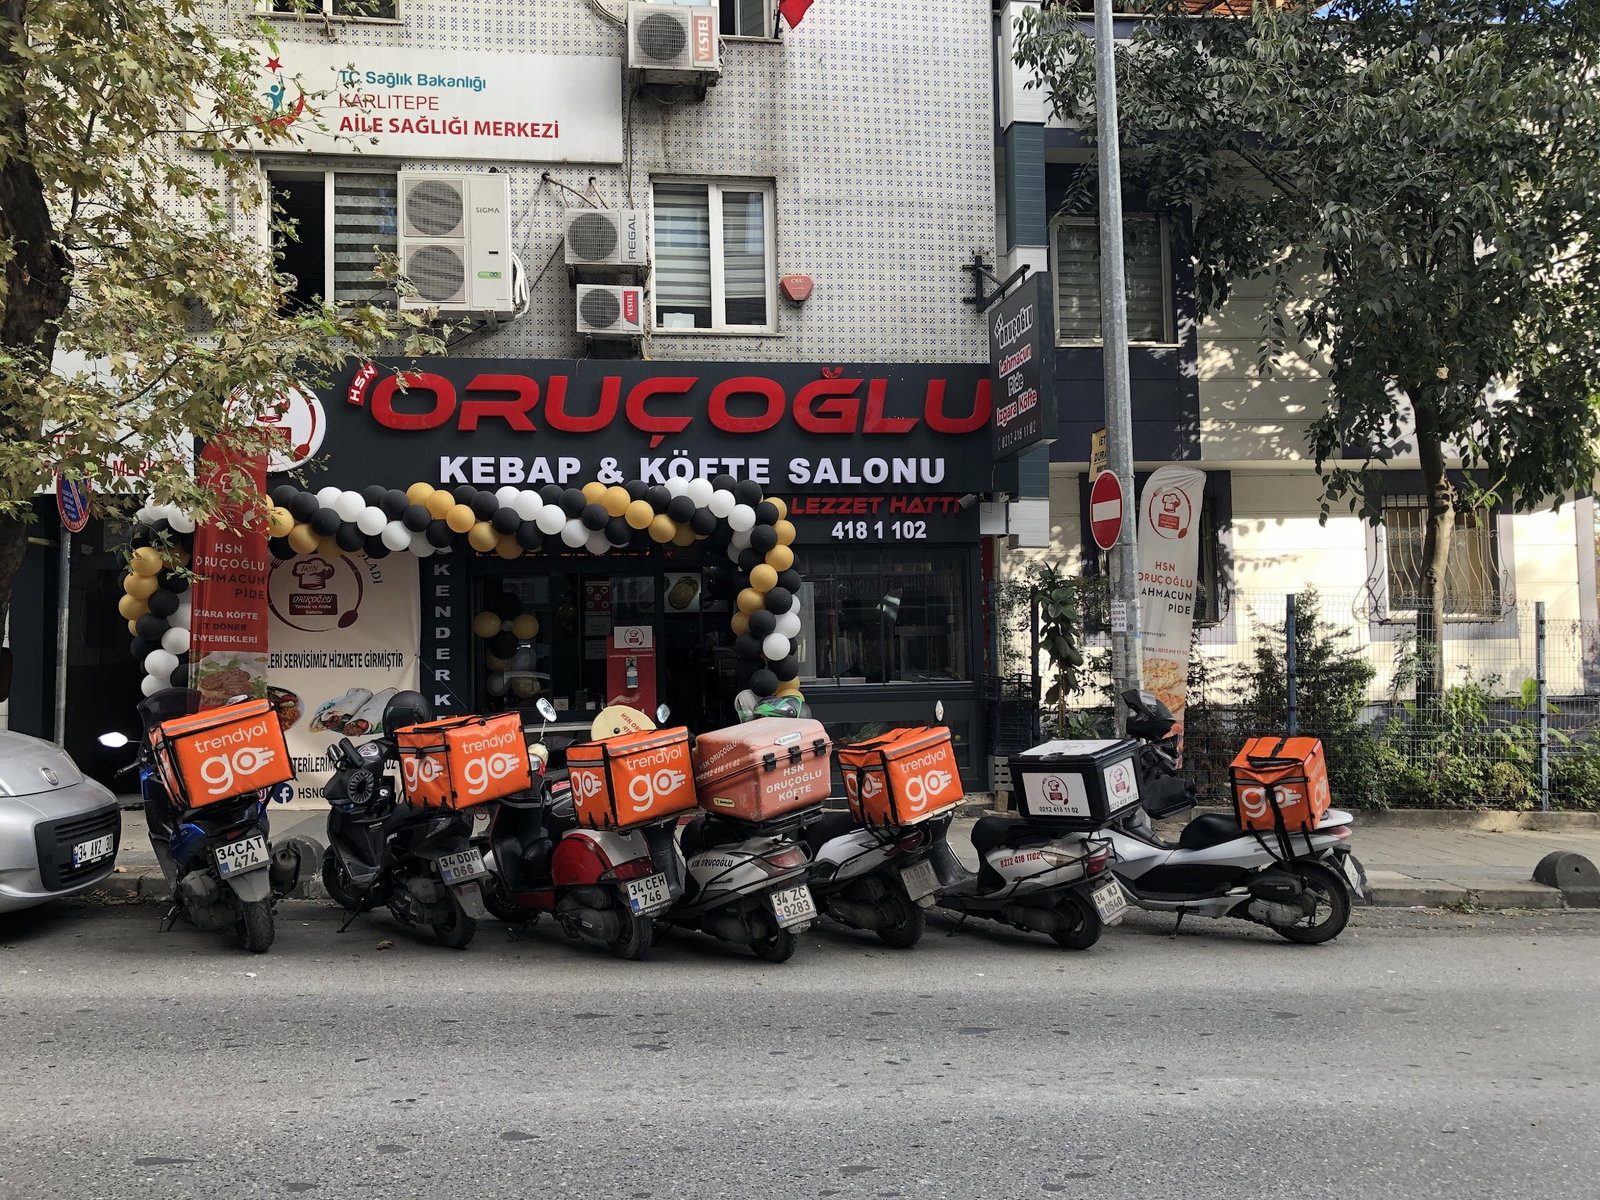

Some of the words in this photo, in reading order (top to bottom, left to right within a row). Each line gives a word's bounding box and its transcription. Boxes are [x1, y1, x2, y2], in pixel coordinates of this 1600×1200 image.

[699, 17, 709, 61] VESTEL
[366, 71, 413, 88] Sağlık
[417, 73, 487, 92] Bakanlığı
[339, 93, 439, 111] KARLITEPE
[339, 113, 383, 133] AİLE
[389, 115, 468, 135] SAĞLIĞI
[474, 120, 559, 138] MERKEZİ
[475, 206, 500, 214] SIGMA
[628, 213, 637, 260] REGAL
[348, 364, 376, 403] HSN
[1008, 371, 1024, 397] Pide
[371, 367, 992, 448] ORUÇOĞLU
[440, 456, 581, 484] KEBAP
[597, 457, 625, 484] &
[640, 450, 770, 484] KÖFTE
[788, 457, 945, 485] SALONU
[791, 496, 886, 515] LEZZET
[832, 521, 867, 540] 418
[874, 521, 884, 539] 1
[892, 521, 927, 539] 102
[215, 543, 243, 554] HSN
[1155, 561, 1176, 572] HSN
[235, 587, 264, 599] PİDE
[1141, 587, 1192, 601] AHMACUN
[227, 611, 258, 619] KÖFTE
[1168, 603, 1191, 615] PİDE
[213, 623, 247, 631] DÖNER
[284, 650, 327, 668] SERVİSİMİZ
[329, 650, 362, 667] HİZMETE
[364, 650, 403, 671] GİRMİŞTİR
[620, 712, 632, 724] HSN
[194, 721, 268, 754] trendyol
[462, 730, 516, 755] trendyol
[625, 747, 682, 771] trendyol
[900, 747, 947, 774] trendyol
[201, 747, 275, 795] go
[464, 752, 520, 795] go
[783, 763, 805, 777] HSN
[571, 770, 602, 807] go
[628, 769, 686, 812] go
[766, 769, 822, 794] ORUÇOĞLU
[905, 769, 952, 812] go
[79, 844, 87, 860] 34
[1015, 855, 1025, 865] 418
[234, 855, 259, 870] 474
[441, 857, 456, 868] 34
[630, 882, 644, 895] 34
[645, 874, 665, 890] CEH
[641, 890, 661, 905] 746
[775, 892, 788, 906] 34
[790, 887, 806, 901] ZC
[1095, 893, 1105, 904] 34
[784, 899, 810, 917] 9283
